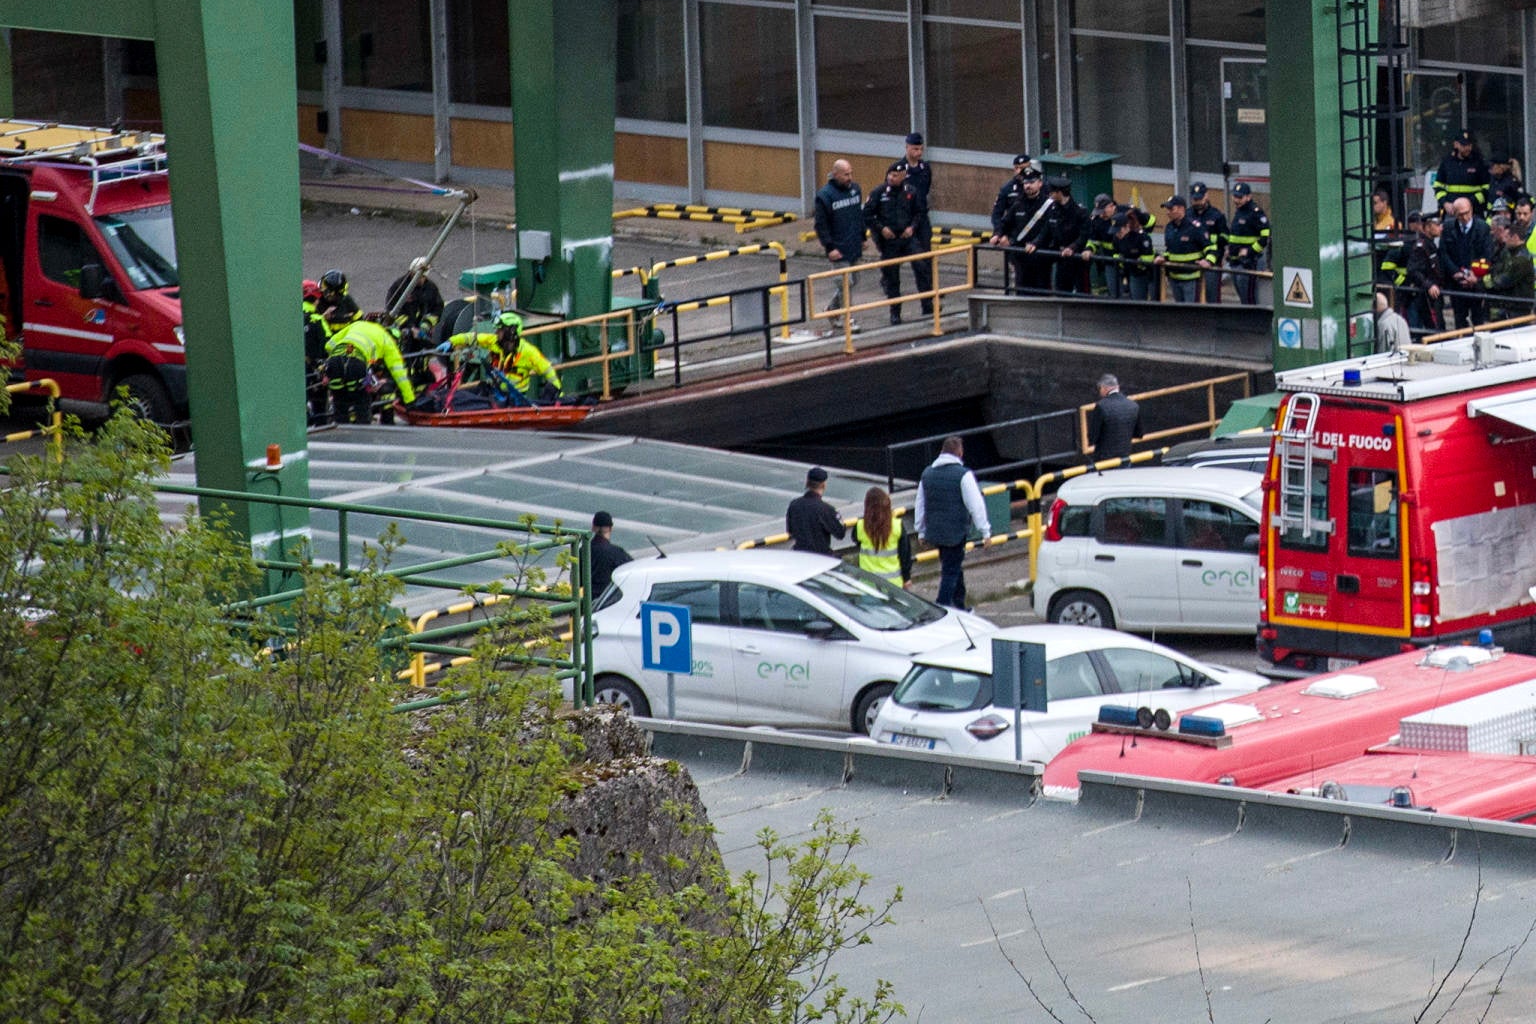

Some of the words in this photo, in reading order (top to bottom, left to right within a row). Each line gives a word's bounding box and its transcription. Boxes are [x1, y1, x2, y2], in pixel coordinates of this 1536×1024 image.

[1322, 432, 1346, 447] DEL
[1348, 435, 1392, 452] FUOCO
[1202, 566, 1254, 587] enel
[1280, 567, 1303, 577] IVECO
[650, 610, 681, 664] P
[757, 660, 810, 681] enel
